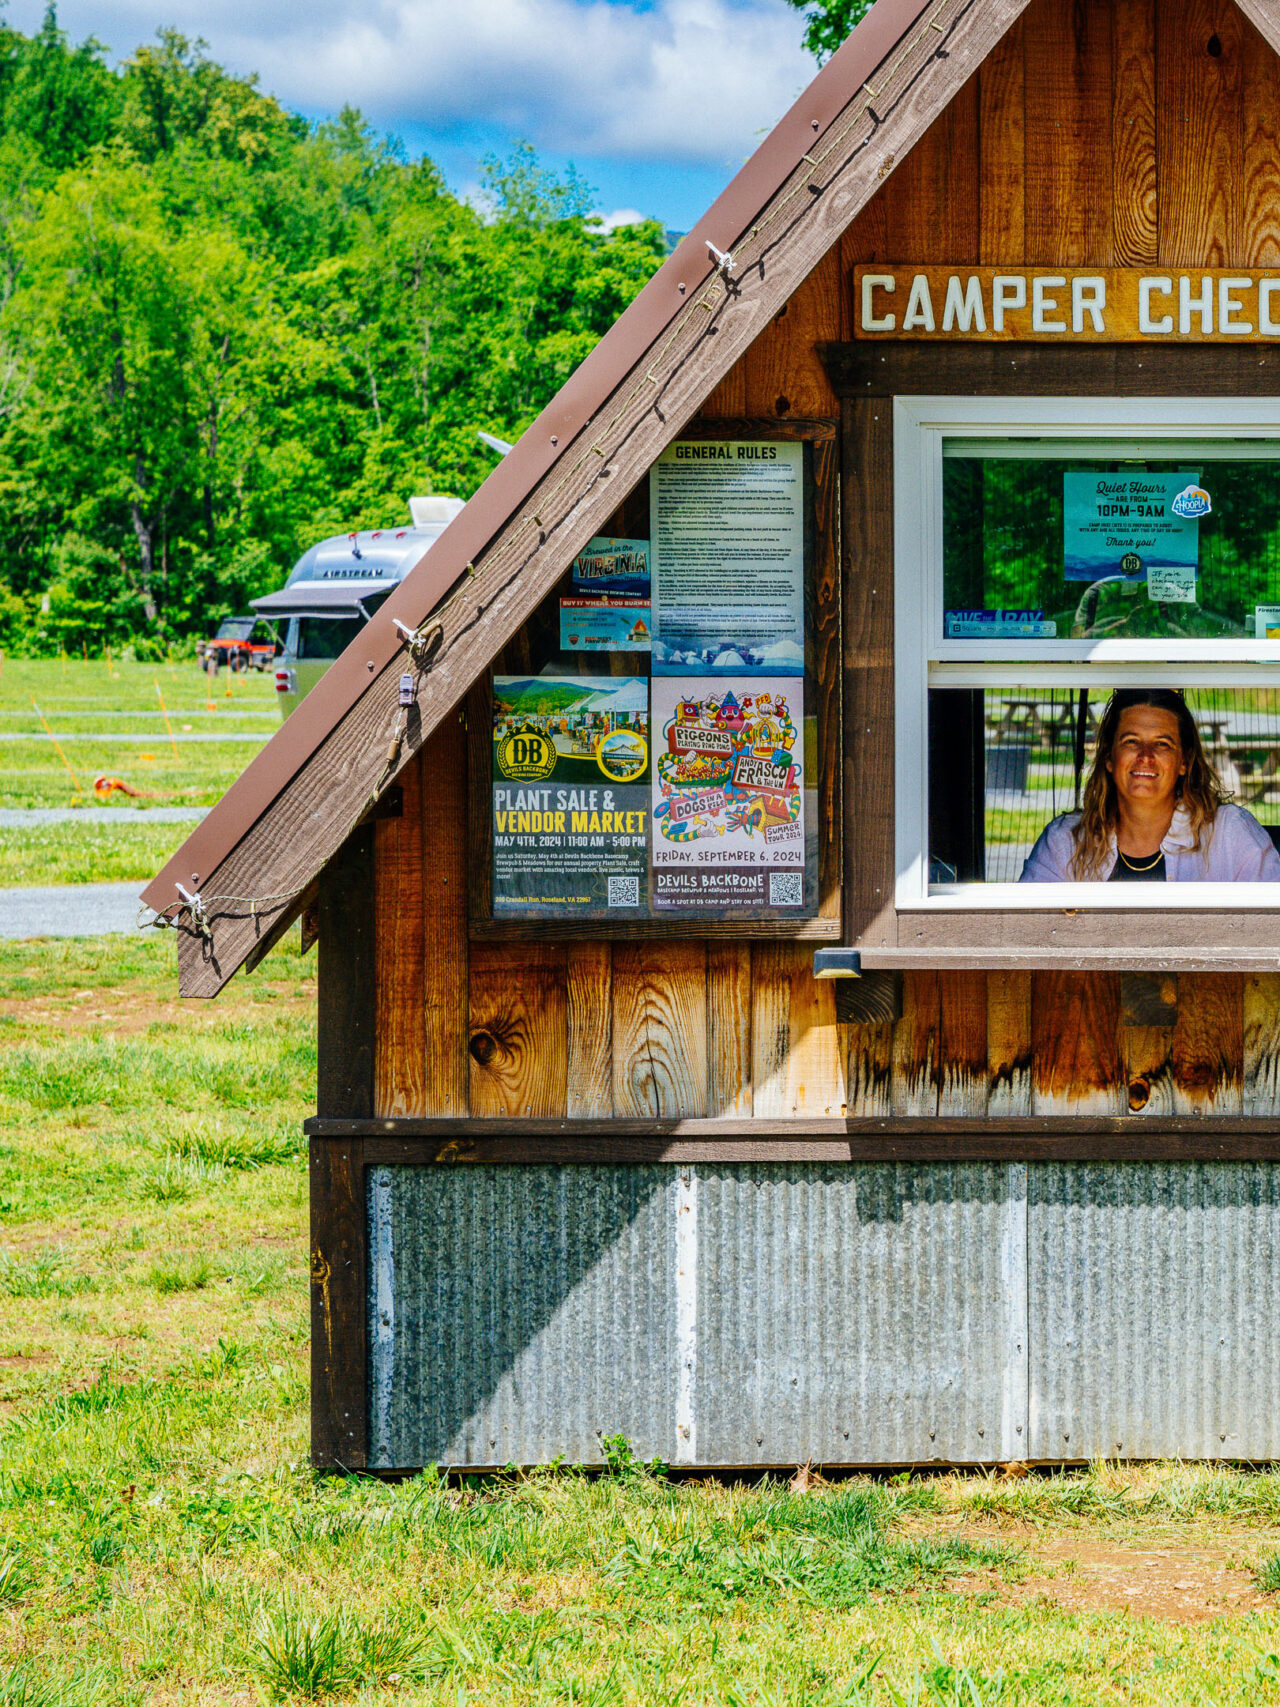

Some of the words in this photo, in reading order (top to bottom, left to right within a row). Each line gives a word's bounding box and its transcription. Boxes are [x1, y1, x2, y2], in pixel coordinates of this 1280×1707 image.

[861, 274, 1106, 334] CAMPER
[675, 446, 733, 459] GENERAL
[737, 446, 777, 459] RULES
[1096, 481, 1128, 495] Quiet
[1129, 481, 1167, 494] Hours
[1096, 505, 1165, 517] 10PM-9AM
[622, 544, 634, 552] the
[1105, 536, 1134, 547] Thank
[1135, 538, 1157, 549] you!
[577, 552, 648, 579] VIRGINIA
[1125, 557, 1137, 569] DB
[323, 569, 384, 578] AIRSTREAM
[676, 729, 730, 744] PiGeONS
[512, 738, 543, 764] DB
[740, 758, 759, 768] ANDY
[495, 789, 551, 811] PLANT
[557, 789, 598, 811] SALE
[603, 790, 615, 811] &
[676, 799, 706, 818] DOGS
[495, 811, 566, 833] VENDOR
[571, 811, 647, 833] MARKET
[767, 823, 800, 836] SUMMER
[495, 836, 514, 847] MAY
[539, 836, 561, 847] 2024
[567, 836, 588, 847] 11:00
[590, 836, 604, 847] AM
[612, 836, 630, 847] 5:00
[632, 836, 646, 847] PM
[768, 834, 784, 843] TOUR
[786, 831, 801, 840] 2024
[656, 850, 694, 863] FRIDAY,
[698, 851, 756, 862] SEPTEMBER
[773, 851, 801, 862] 2024
[657, 874, 697, 887] DEVILS
[701, 874, 764, 887] BACKBONE
